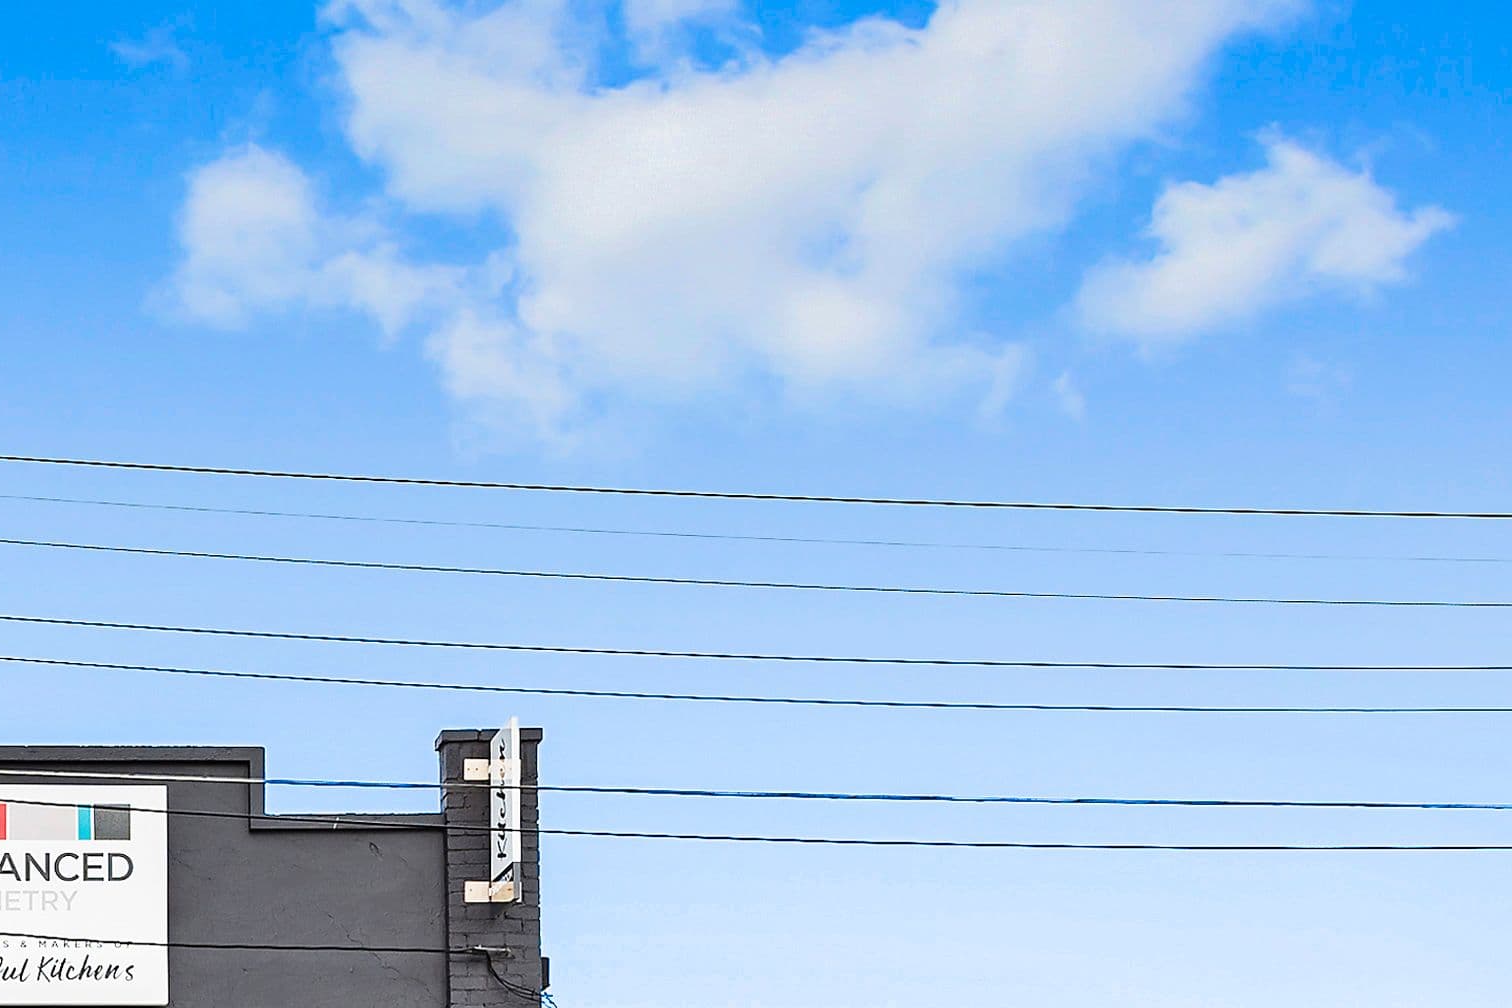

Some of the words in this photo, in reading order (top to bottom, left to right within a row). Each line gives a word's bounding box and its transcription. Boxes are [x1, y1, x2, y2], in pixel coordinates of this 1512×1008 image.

[20, 940, 28, 948] &
[38, 939, 104, 949] MAKERS
[36, 954, 136, 984] Kitchens
